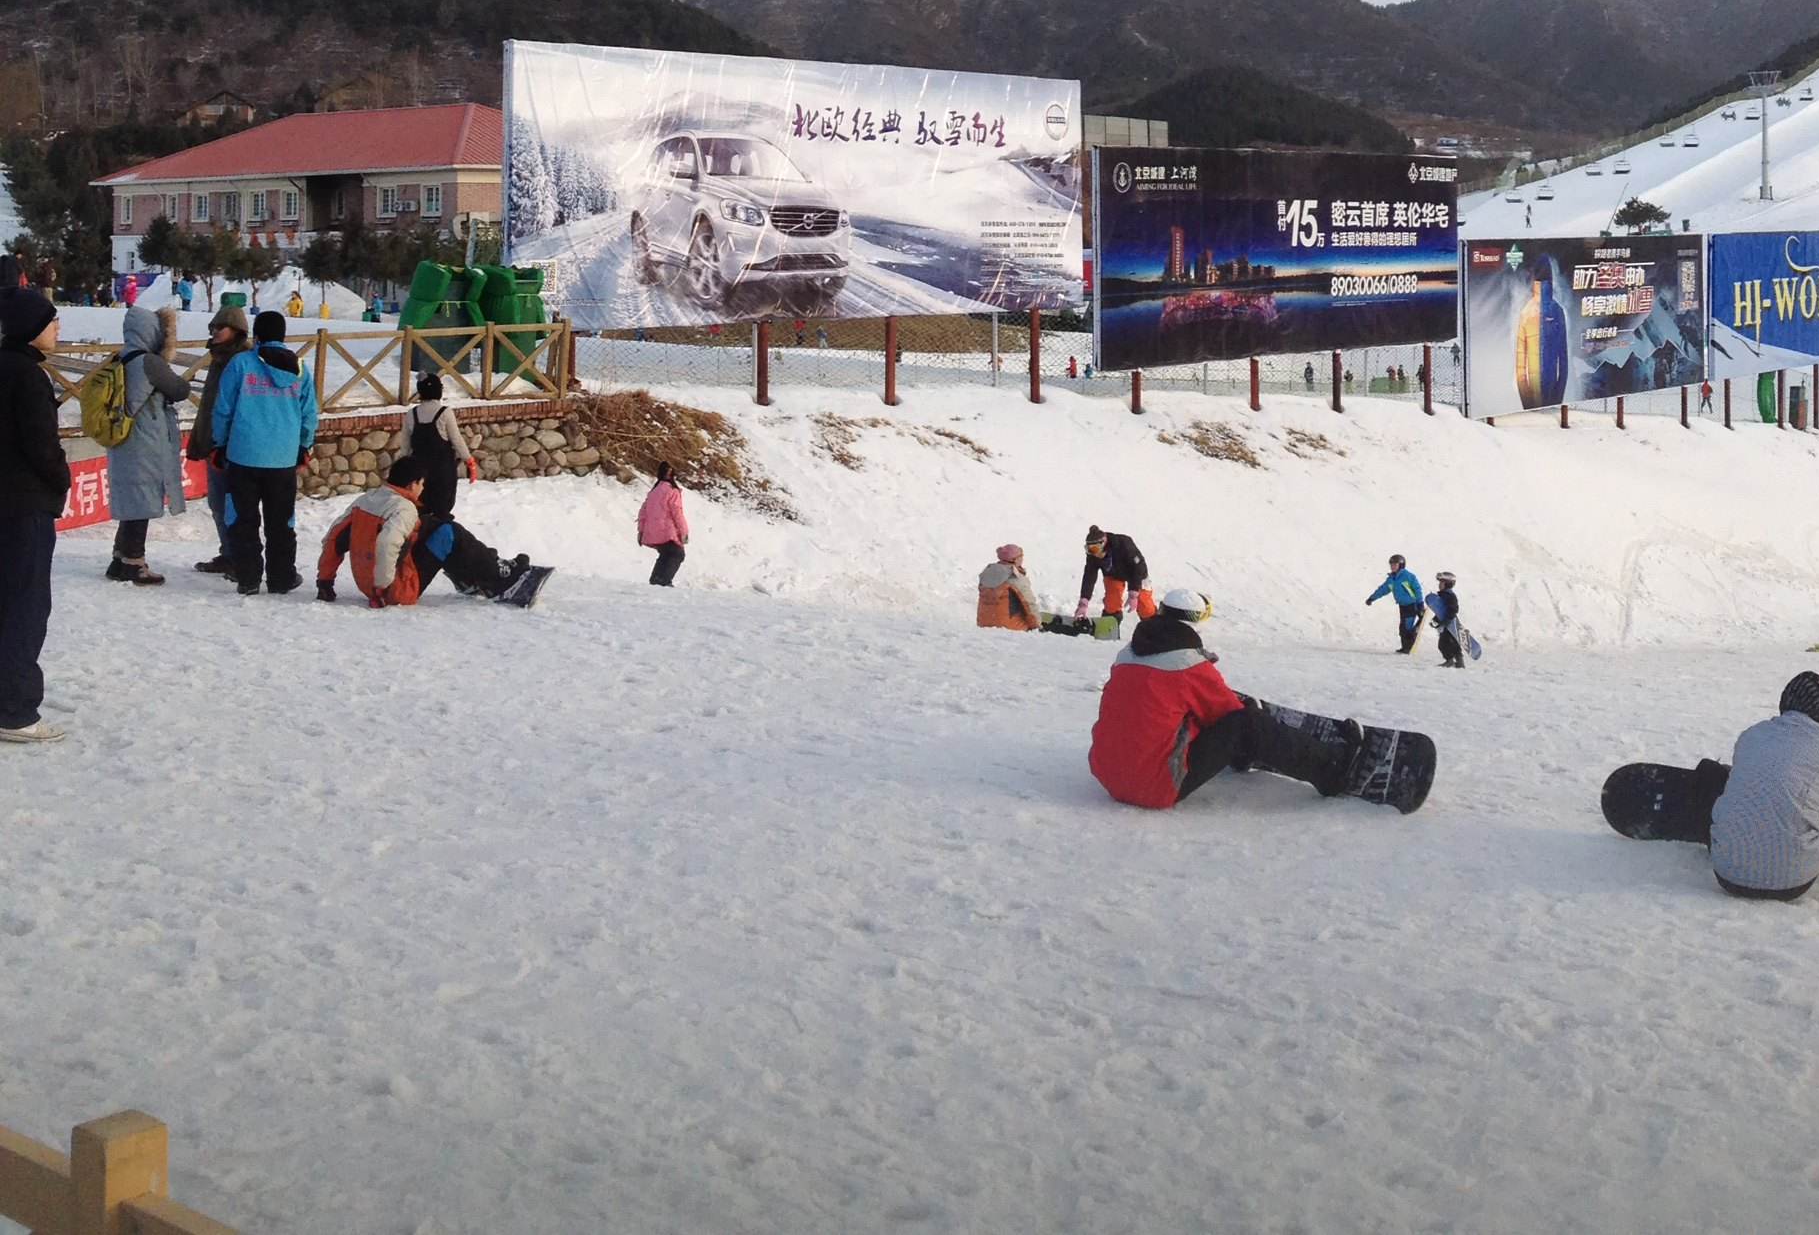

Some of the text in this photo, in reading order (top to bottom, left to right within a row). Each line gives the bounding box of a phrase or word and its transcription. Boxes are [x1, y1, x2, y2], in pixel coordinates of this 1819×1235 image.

[1331, 200, 1449, 228] 密云首席 英伦华宅
[1330, 275, 1418, 297] 89030066/0888
